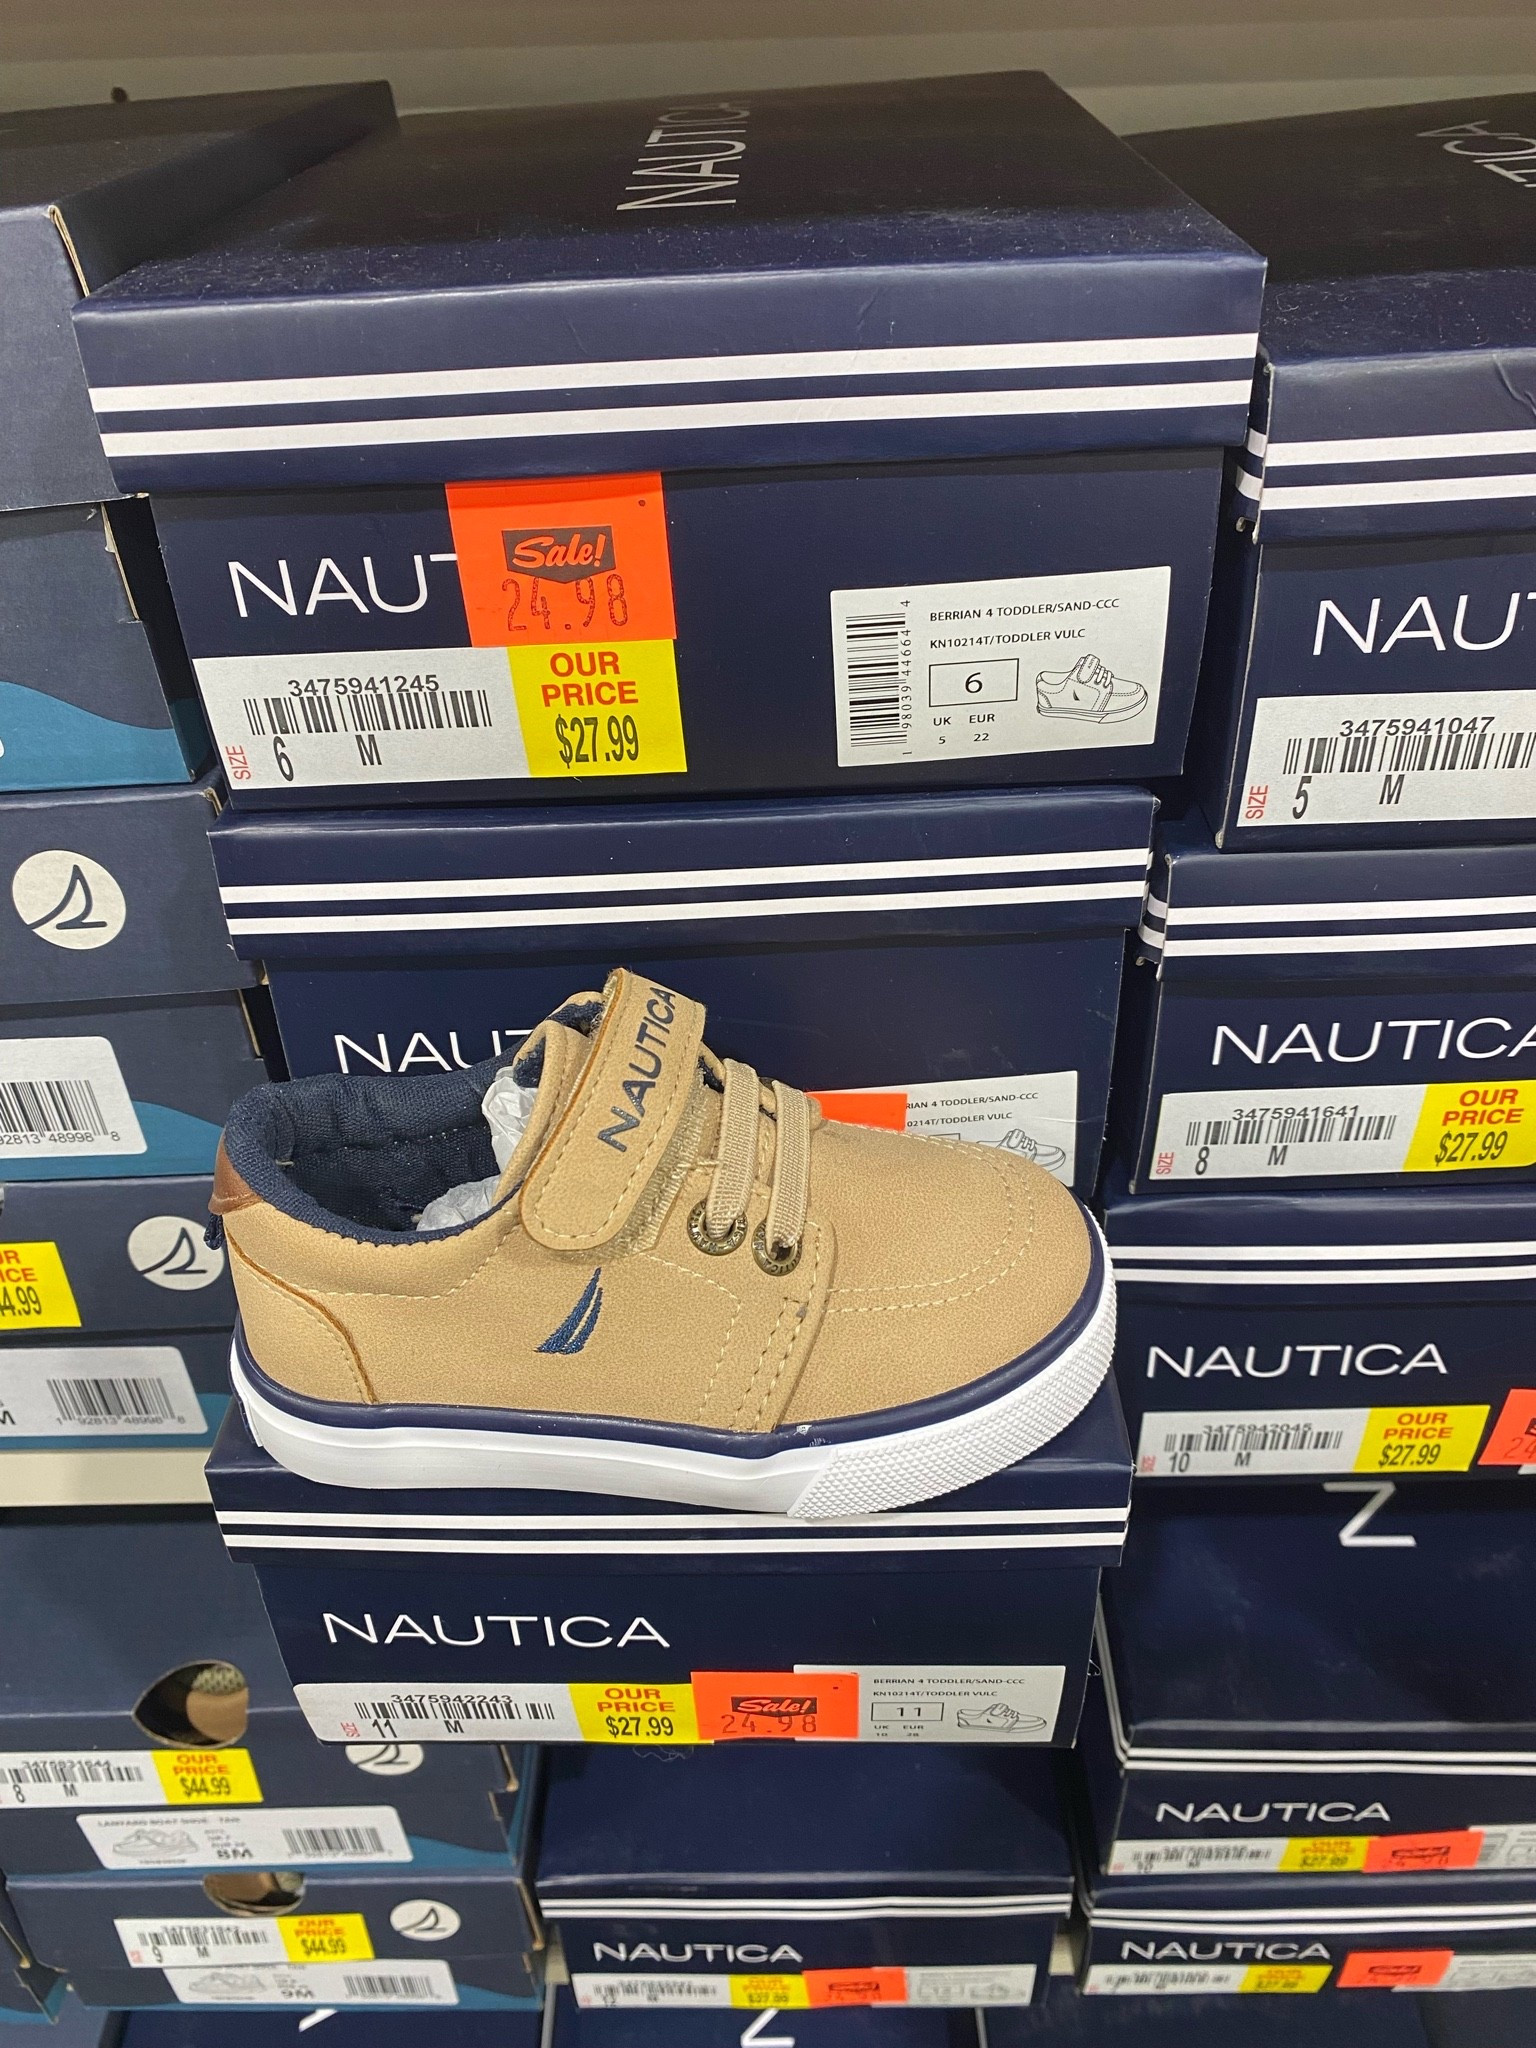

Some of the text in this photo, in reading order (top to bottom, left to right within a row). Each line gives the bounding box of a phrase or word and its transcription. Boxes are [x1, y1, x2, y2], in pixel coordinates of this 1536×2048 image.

[1416, 120, 1536, 188] TICA
[512, 534, 606, 569] Sale!
[502, 573, 628, 632] 24.98
[929, 598, 1120, 622] BERRIAN 4 TODDLER/SAND-CCC
[1312, 592, 1536, 656] NAU
[929, 628, 1086, 649] KN10214T/TODDLER VULC
[901, 629, 911, 676] 44664
[549, 651, 621, 677] OUR
[287, 674, 440, 698] 3475941245
[541, 680, 639, 707] PRICE
[964, 672, 983, 694] 6
[902, 685, 912, 729] 98039
[933, 714, 996, 726] UK EUR
[1339, 716, 1496, 738] 3475941047
[554, 714, 640, 769] $27.99
[938, 733, 990, 744] 5 22
[226, 744, 251, 780] SIZE
[273, 734, 382, 782] 6 M
[1245, 784, 1269, 821] SIZE
[1291, 774, 1405, 820] 5 M
[334, 1029, 533, 1074] NAU
[598, 987, 676, 1153] NAUTICA
[940, 1092, 1039, 1107] TODDLER/SAND-CCC
[1458, 1088, 1519, 1107] OUR
[987, 1112, 1013, 1121] VULC
[1232, 1105, 1360, 1121] 3475941641
[1441, 1108, 1525, 1127] PRICE
[48, 1132, 95, 1143] 48998
[110, 1131, 120, 1142] 8
[1434, 1130, 1509, 1167] $27.99
[1155, 1151, 1175, 1176] SIZE
[1194, 1145, 1288, 1176] 8 M
[1146, 1343, 1448, 1379] NAUTICA
[1397, 1412, 1447, 1426] OUR
[1383, 1426, 1454, 1440] PRICE
[1169, 1453, 1251, 1473] 10 M
[1378, 1444, 1441, 1469] $27.99
[322, 1613, 670, 1648] NAUTICA
[391, 1694, 512, 1704] 3475942243
[604, 1688, 661, 1700] OUR
[597, 1701, 675, 1713] PRICE
[737, 1699, 812, 1713] Sale!
[896, 1707, 922, 1717] 11
[372, 1719, 464, 1738] 11 M
[605, 1715, 673, 1738] $27.99
[721, 1713, 816, 1733] 24.98
[176, 1753, 218, 1764] OUR
[173, 1764, 230, 1776] PRICE
[13, 1783, 78, 1803] 8 M
[180, 1777, 231, 1797] $44.99
[1155, 1802, 1390, 1823] NAUTICA
[151, 1945, 164, 1964] 9
[196, 1946, 210, 1959] M
[301, 1938, 347, 1957] $44.99
[592, 1942, 803, 1963] NAUTICA
[1120, 1942, 1331, 1960] NAUTICA
